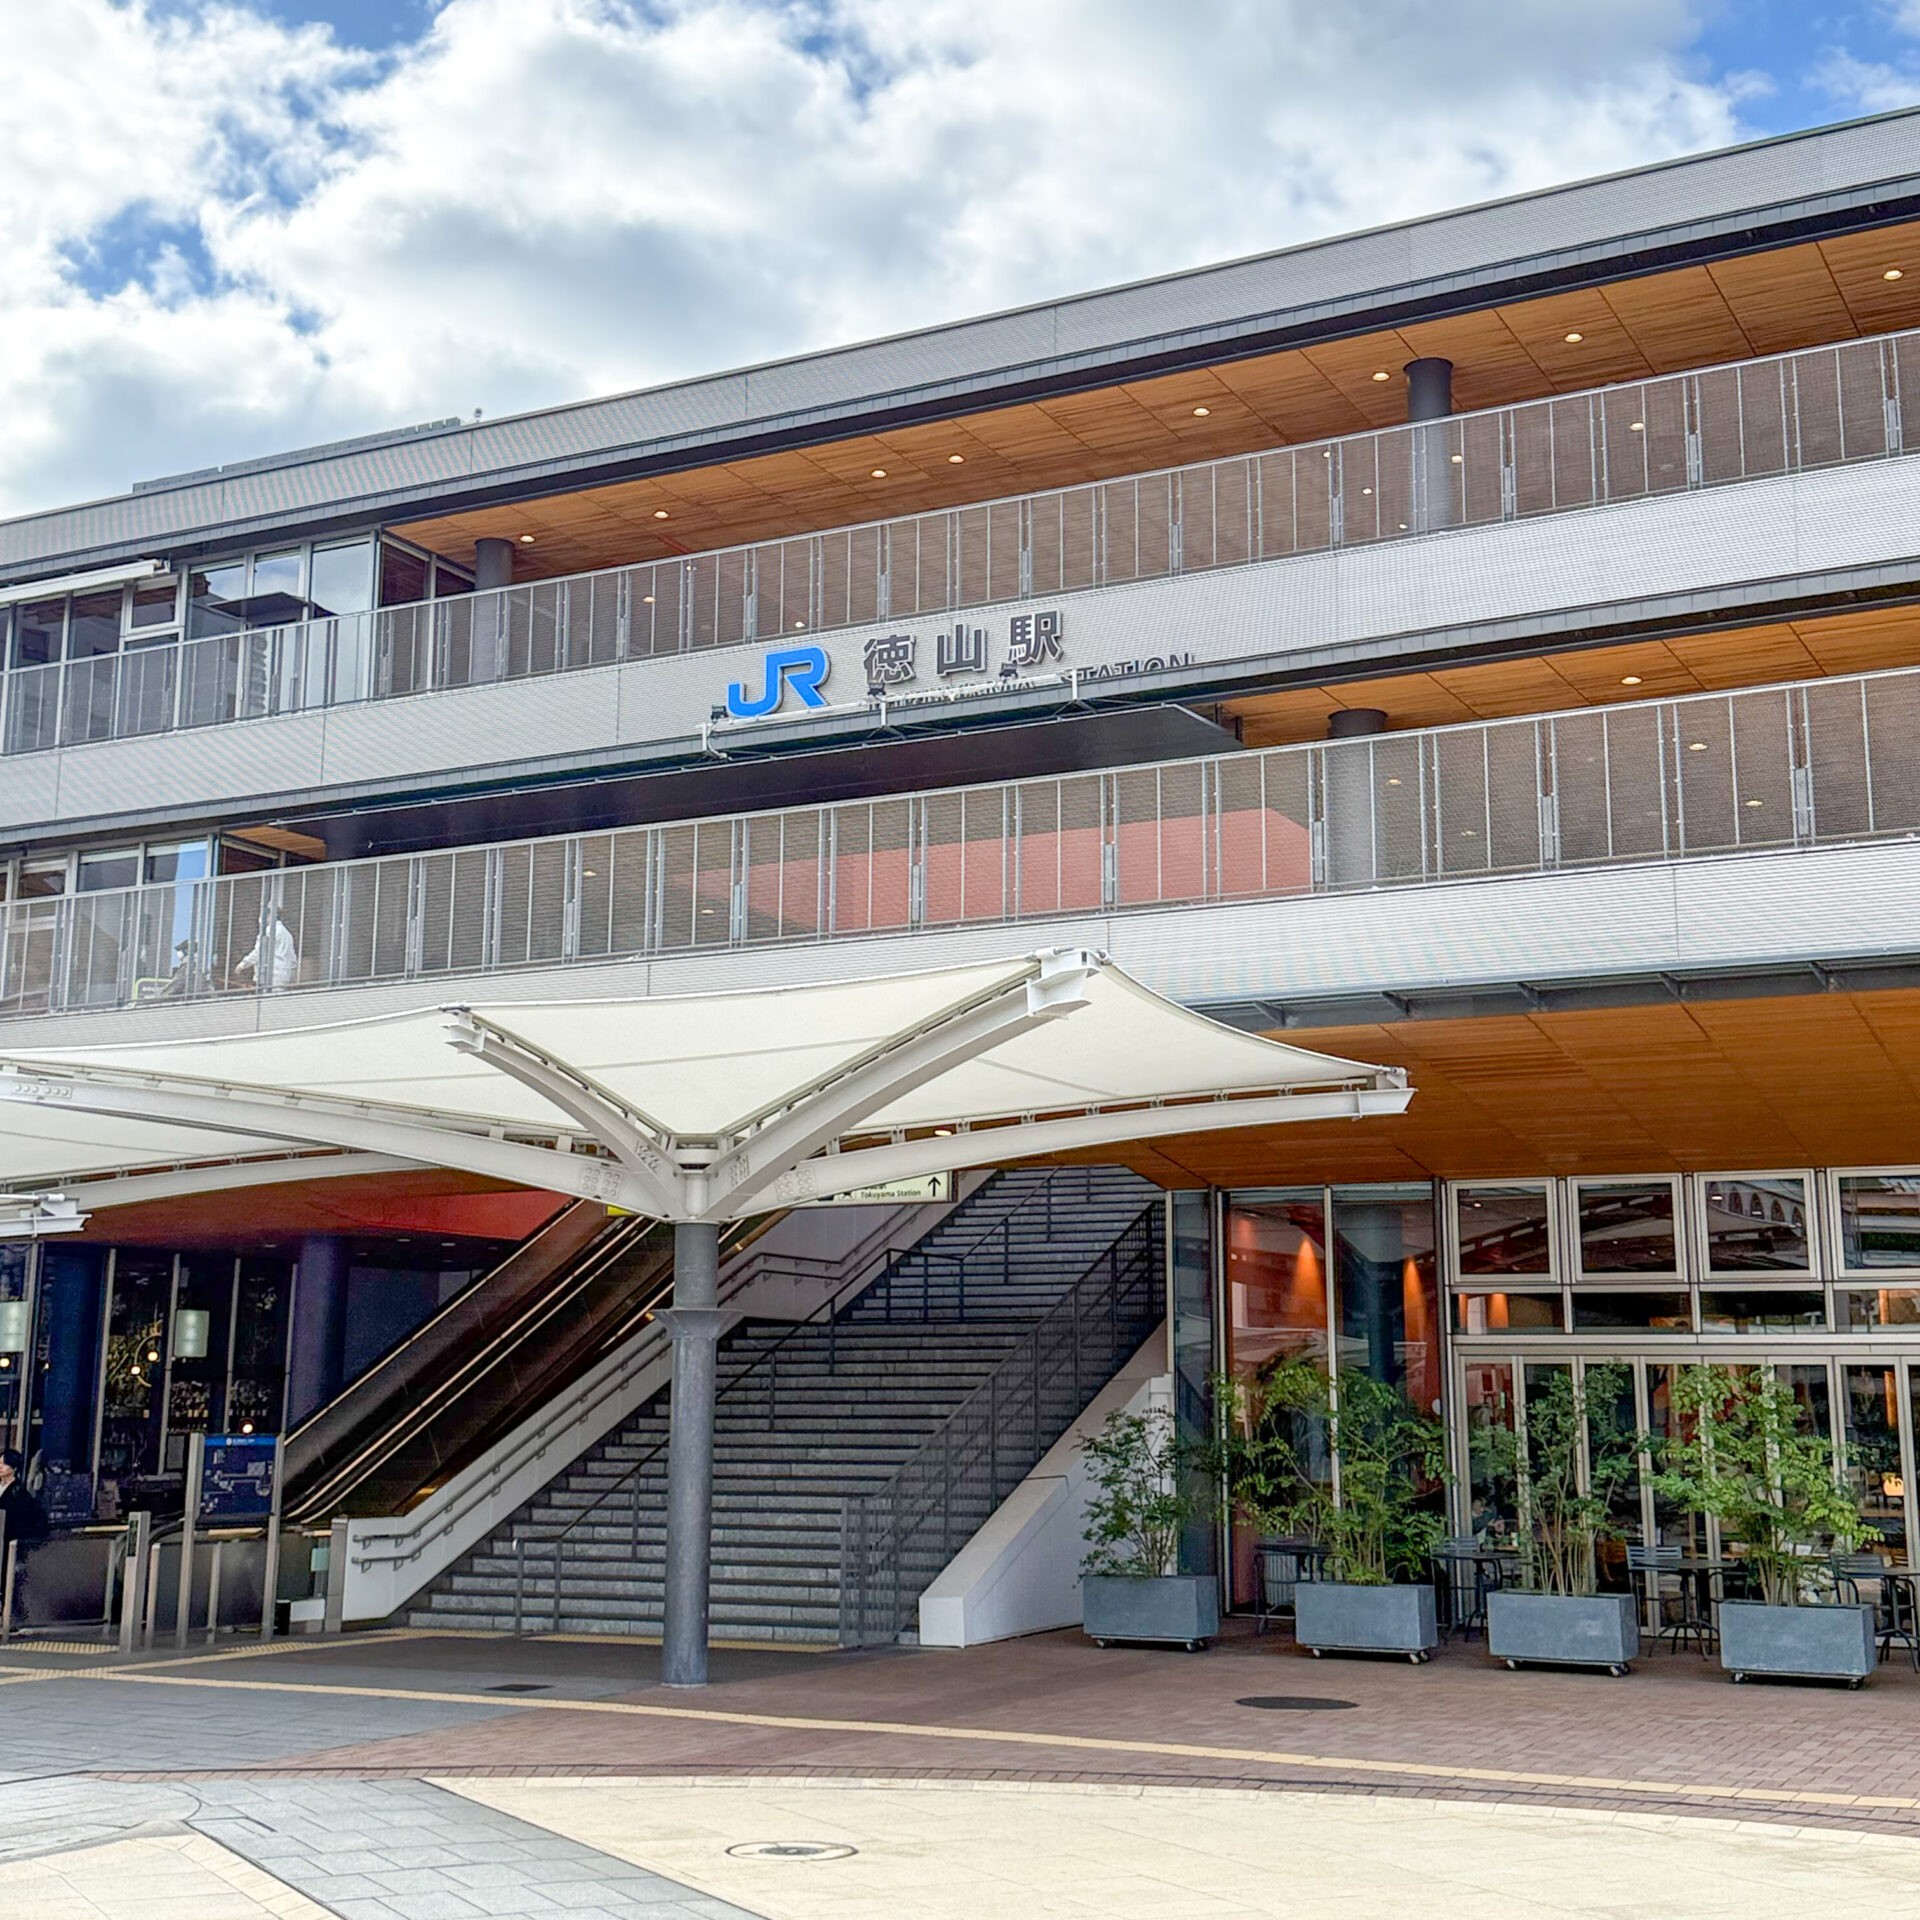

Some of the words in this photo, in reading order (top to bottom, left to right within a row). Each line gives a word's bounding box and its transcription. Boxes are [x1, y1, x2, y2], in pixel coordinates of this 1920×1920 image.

[727, 645, 829, 719] JR
[863, 610, 1062, 685] 徳山駅
[860, 1190, 895, 1199] Tokuyama
[896, 1189, 921, 1197] Station
